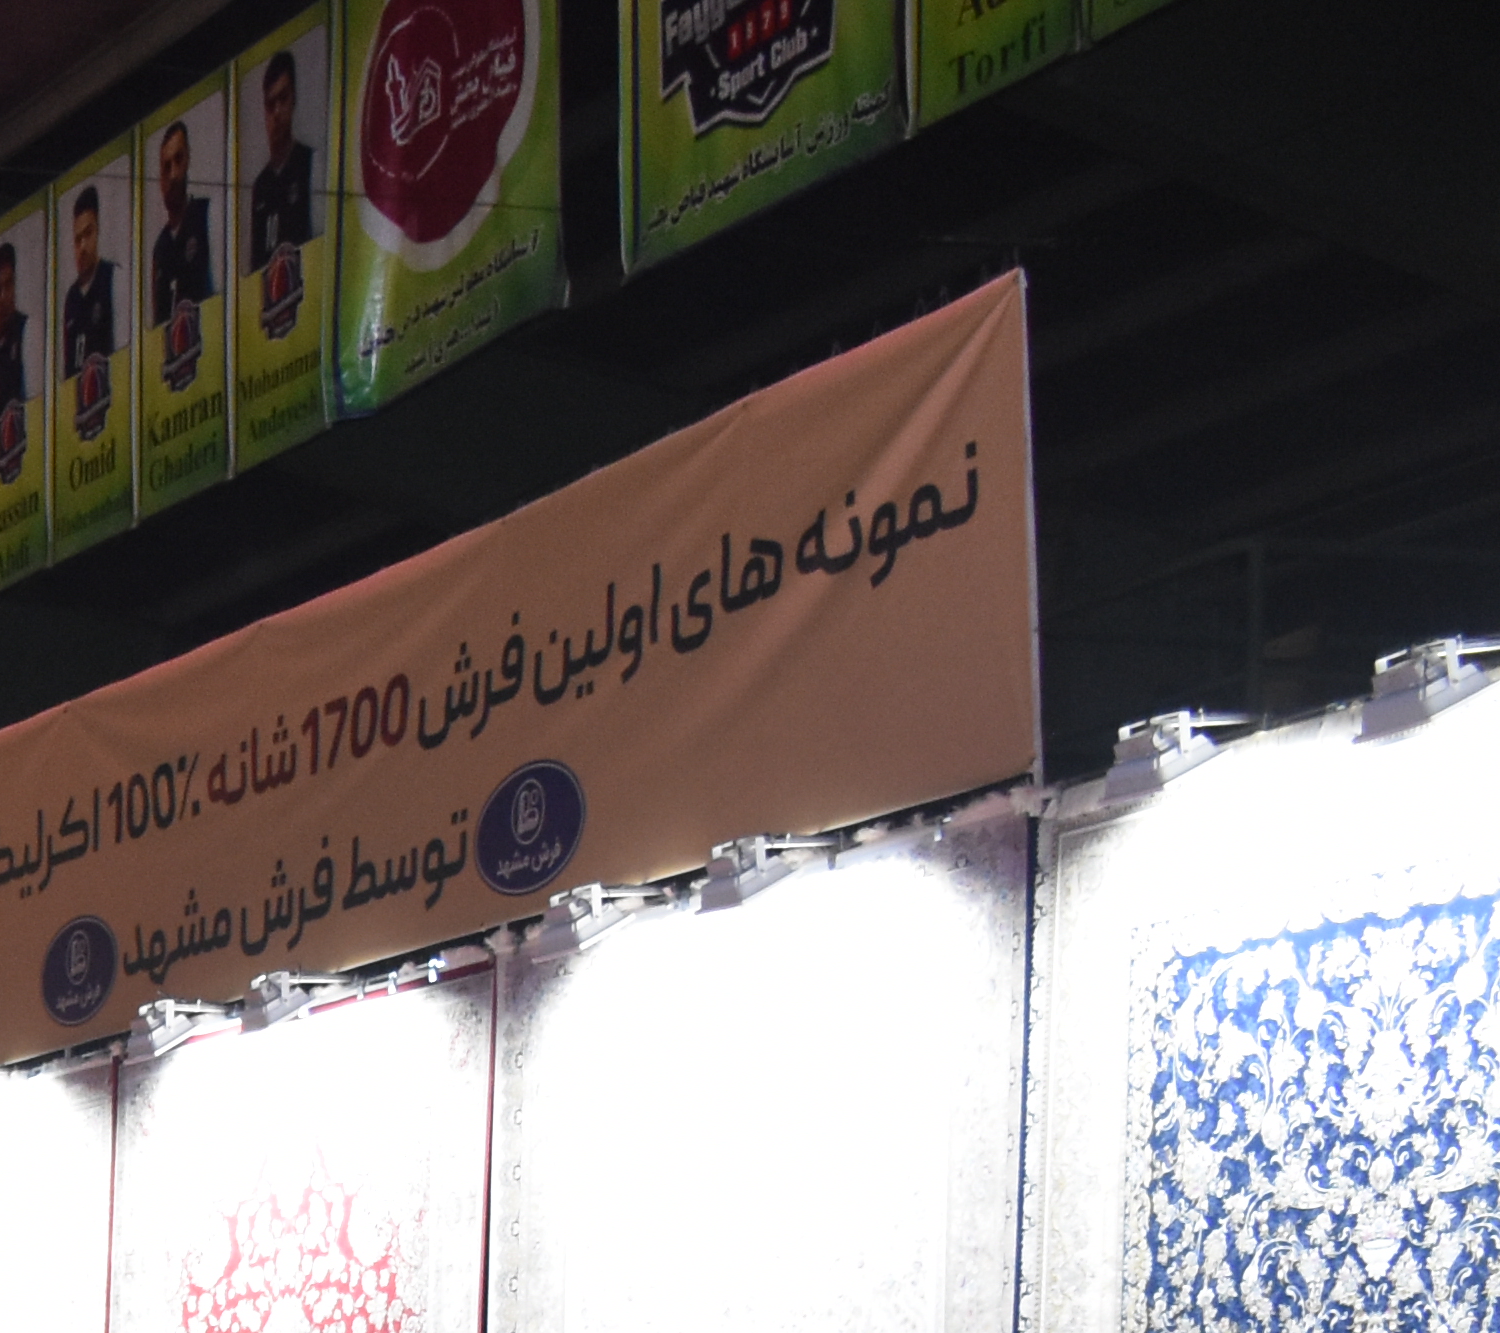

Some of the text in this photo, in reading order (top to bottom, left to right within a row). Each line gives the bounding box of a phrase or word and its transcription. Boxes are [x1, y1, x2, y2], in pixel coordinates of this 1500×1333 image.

[717, 26, 808, 101] Sport Club
[946, 10, 1047, 94] Torfi
[69, 437, 116, 491] Omid
[147, 389, 223, 448] Kamran
[796, 441, 979, 587] نمونه
[533, 563, 661, 705] اولین
[671, 533, 784, 654] های
[302, 671, 411, 776] 1700
[417, 611, 525, 749] فرش
[207, 714, 298, 805] شانه
[123, 809, 469, 985] توسط فرش مشهد
[496, 836, 562, 880] فرش مشهد
